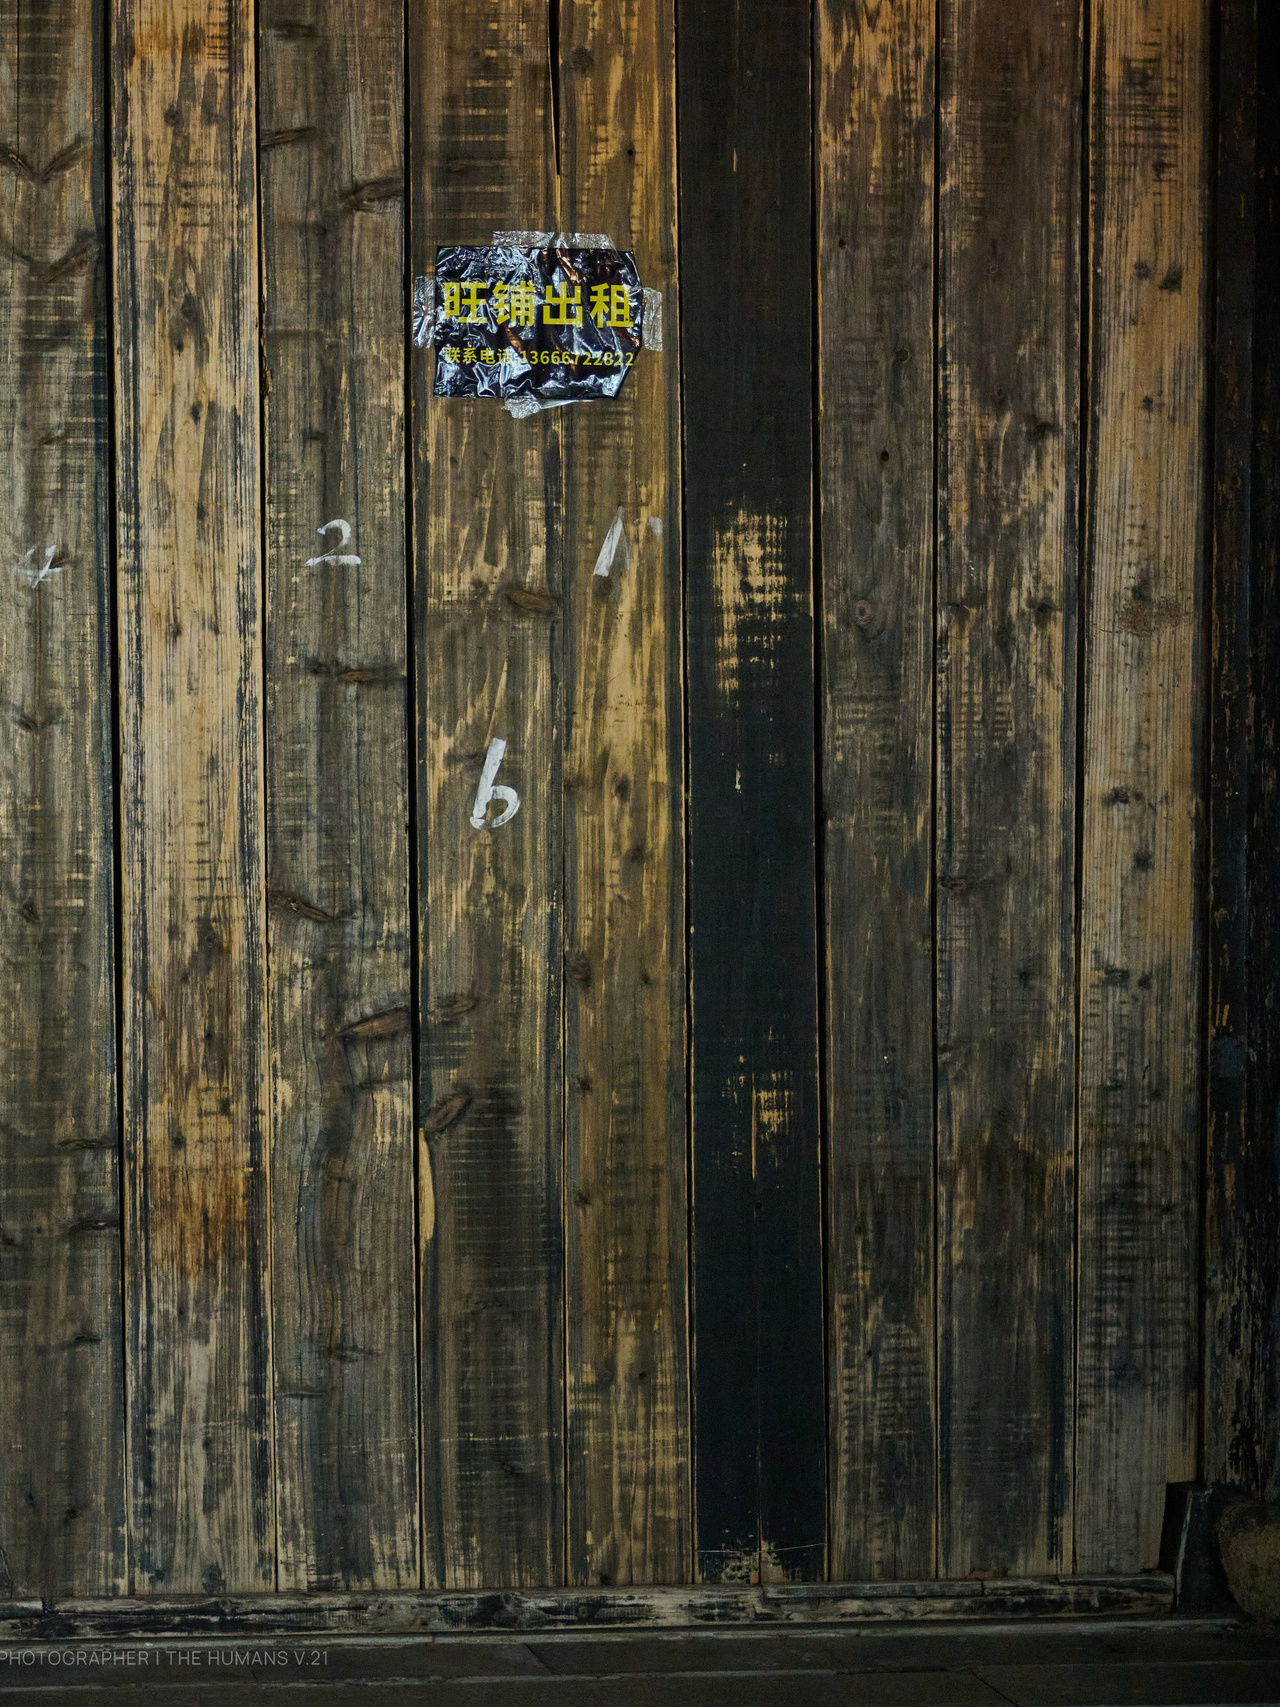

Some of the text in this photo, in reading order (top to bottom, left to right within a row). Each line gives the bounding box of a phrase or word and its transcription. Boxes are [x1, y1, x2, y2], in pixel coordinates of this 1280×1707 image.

[443, 280, 635, 328] 旺铺出租
[303, 518, 362, 567] 2
